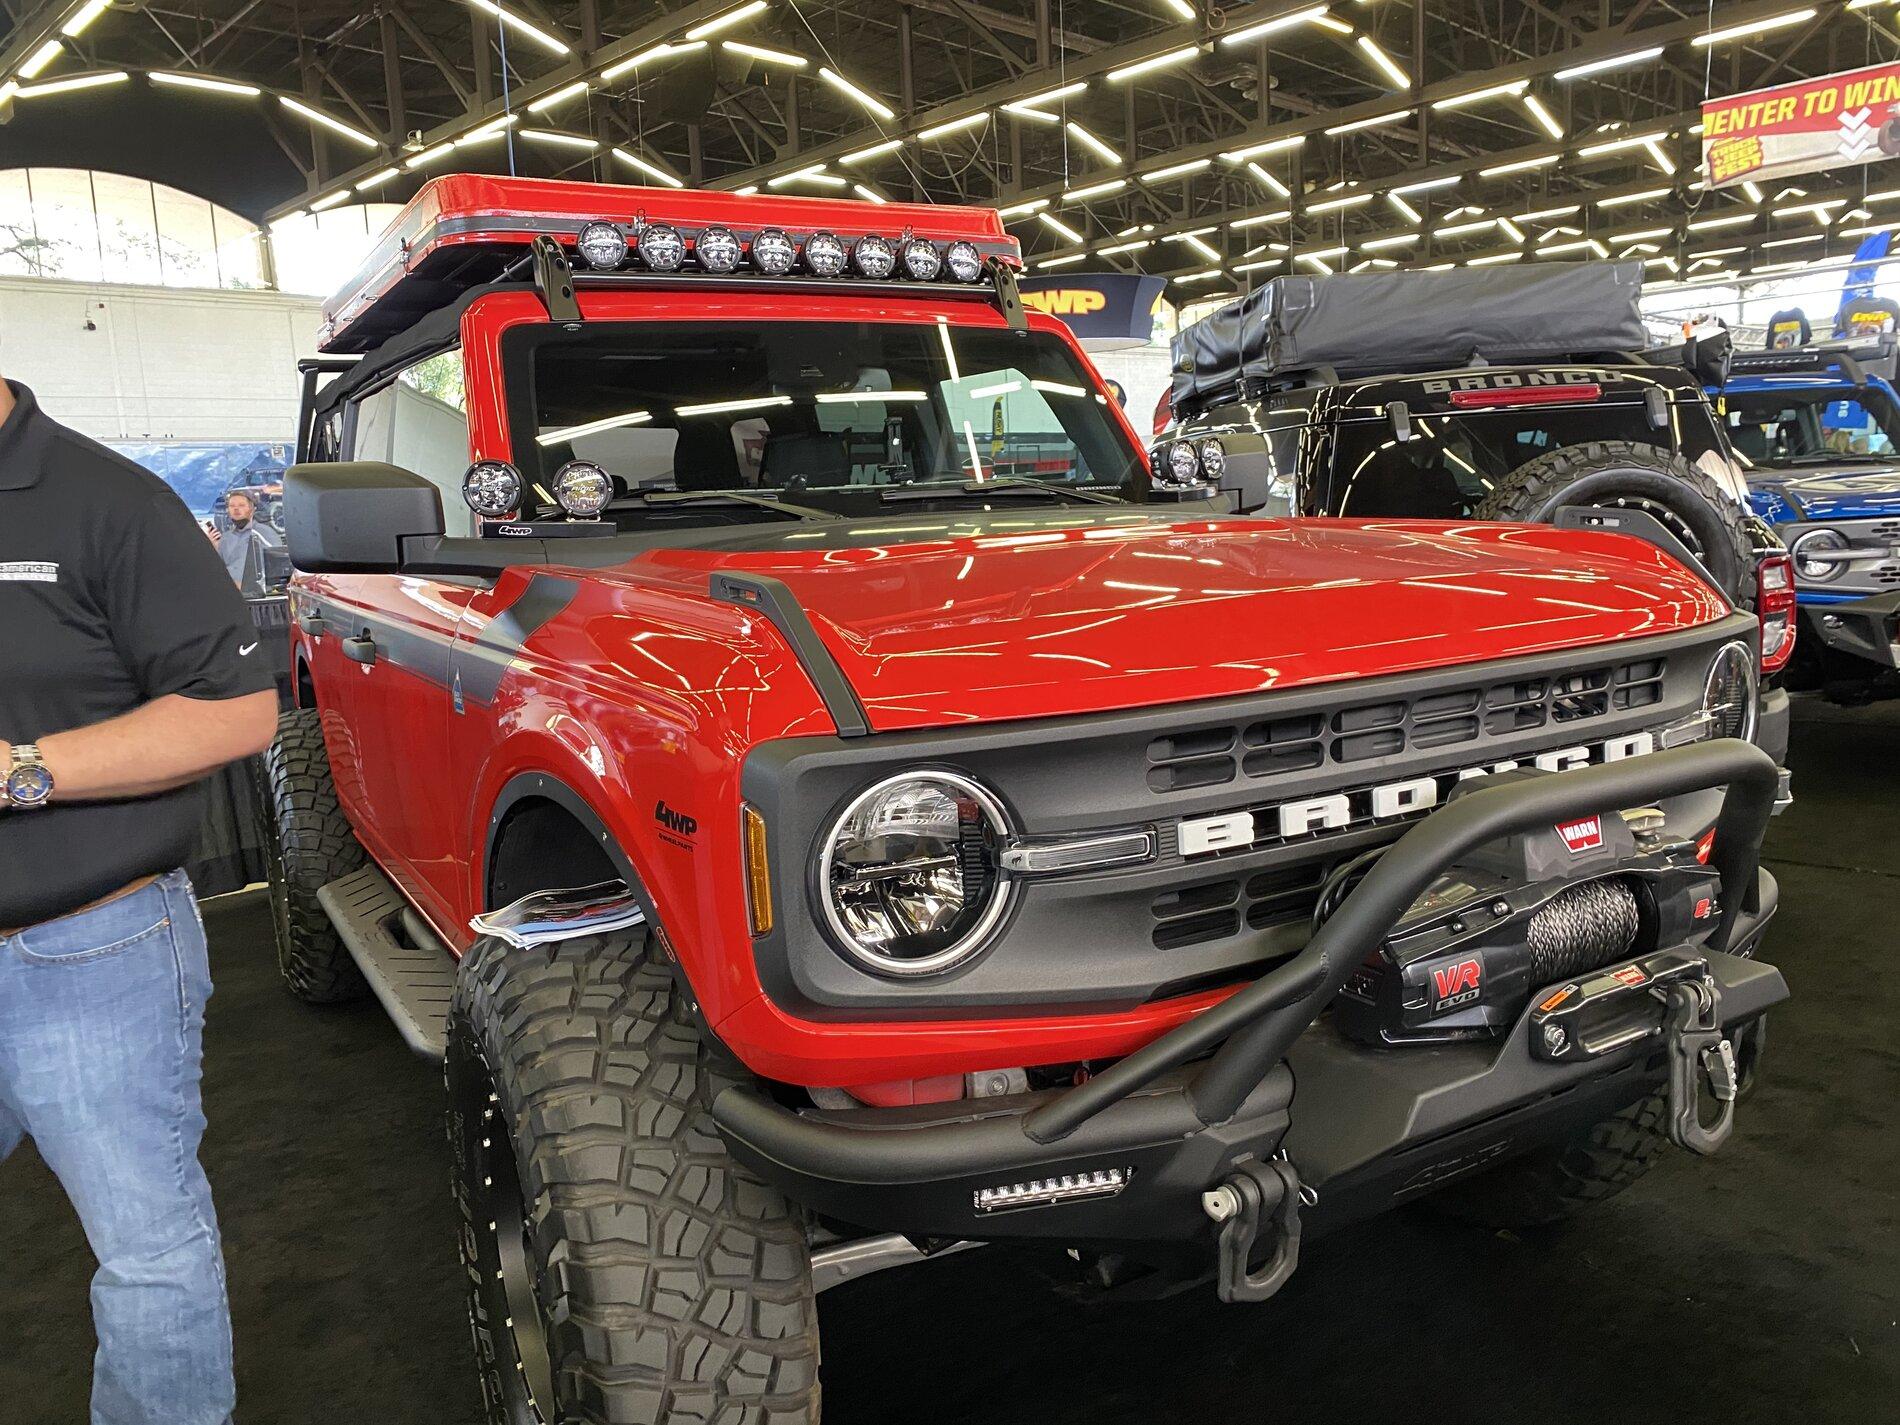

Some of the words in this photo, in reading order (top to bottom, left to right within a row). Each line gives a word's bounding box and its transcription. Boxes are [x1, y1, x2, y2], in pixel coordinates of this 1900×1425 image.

[1713, 96, 1798, 135] ENTER
[1803, 87, 1839, 118] TO
[1844, 75, 1900, 109] WIN
[1422, 370, 1624, 395] BRONCO
[499, 525, 532, 536] 4WP
[0, 565, 57, 574] american
[654, 799, 698, 836] 4WP
[1562, 820, 1598, 842] WARN
[1433, 959, 1481, 999] VR
[1437, 989, 1479, 1011] EVO
